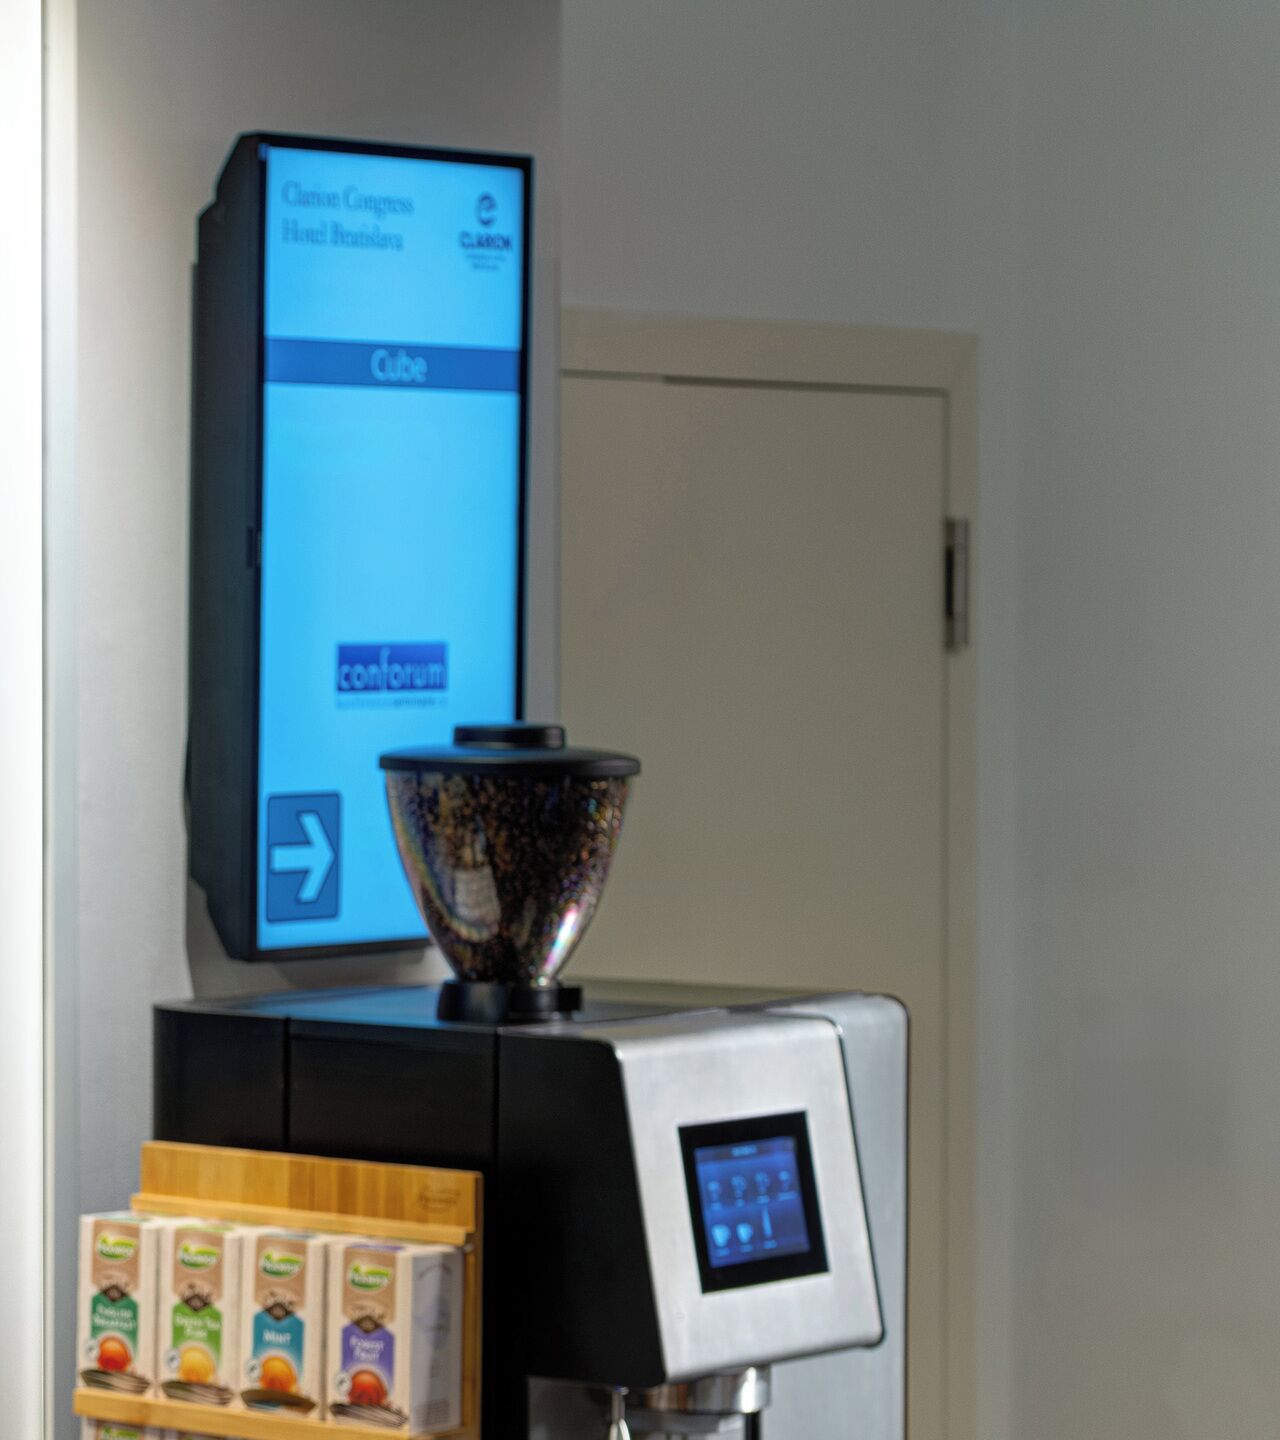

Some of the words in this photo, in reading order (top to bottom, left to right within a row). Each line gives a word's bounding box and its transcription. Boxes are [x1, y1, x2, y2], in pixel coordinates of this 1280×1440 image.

[343, 185, 414, 219] Congress
[370, 348, 428, 384] Cube
[340, 646, 446, 692] conforum
